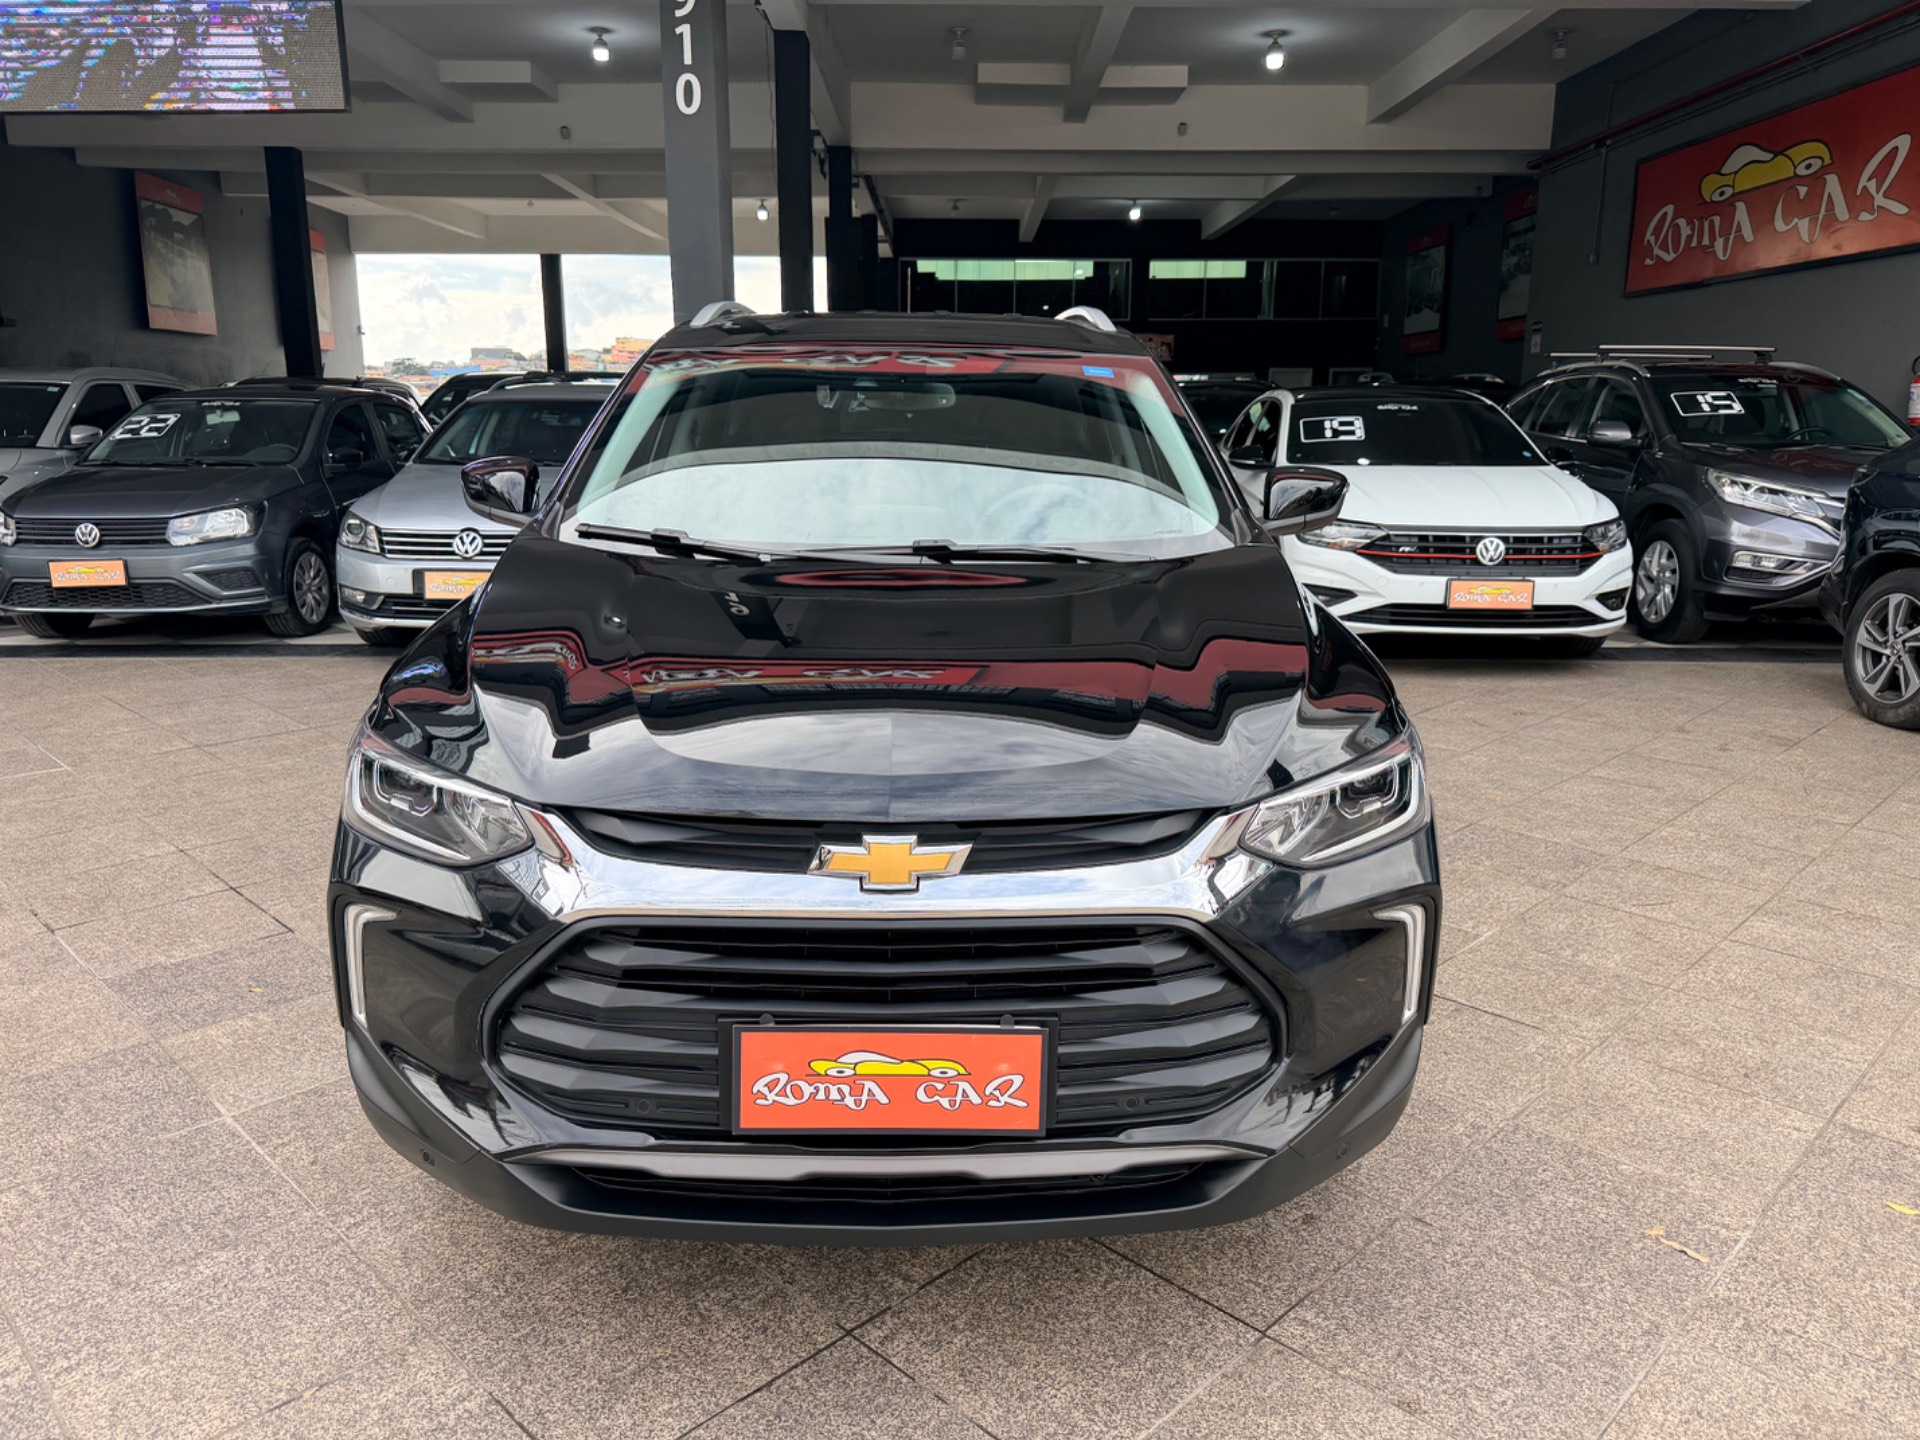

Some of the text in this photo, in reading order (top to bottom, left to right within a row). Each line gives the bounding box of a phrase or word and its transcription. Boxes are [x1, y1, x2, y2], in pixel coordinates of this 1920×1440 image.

[1774, 132, 1911, 244] CAR
[1695, 391, 1743, 414] 15
[1323, 416, 1363, 440] 19
[915, 1074, 1029, 1110] CAR
